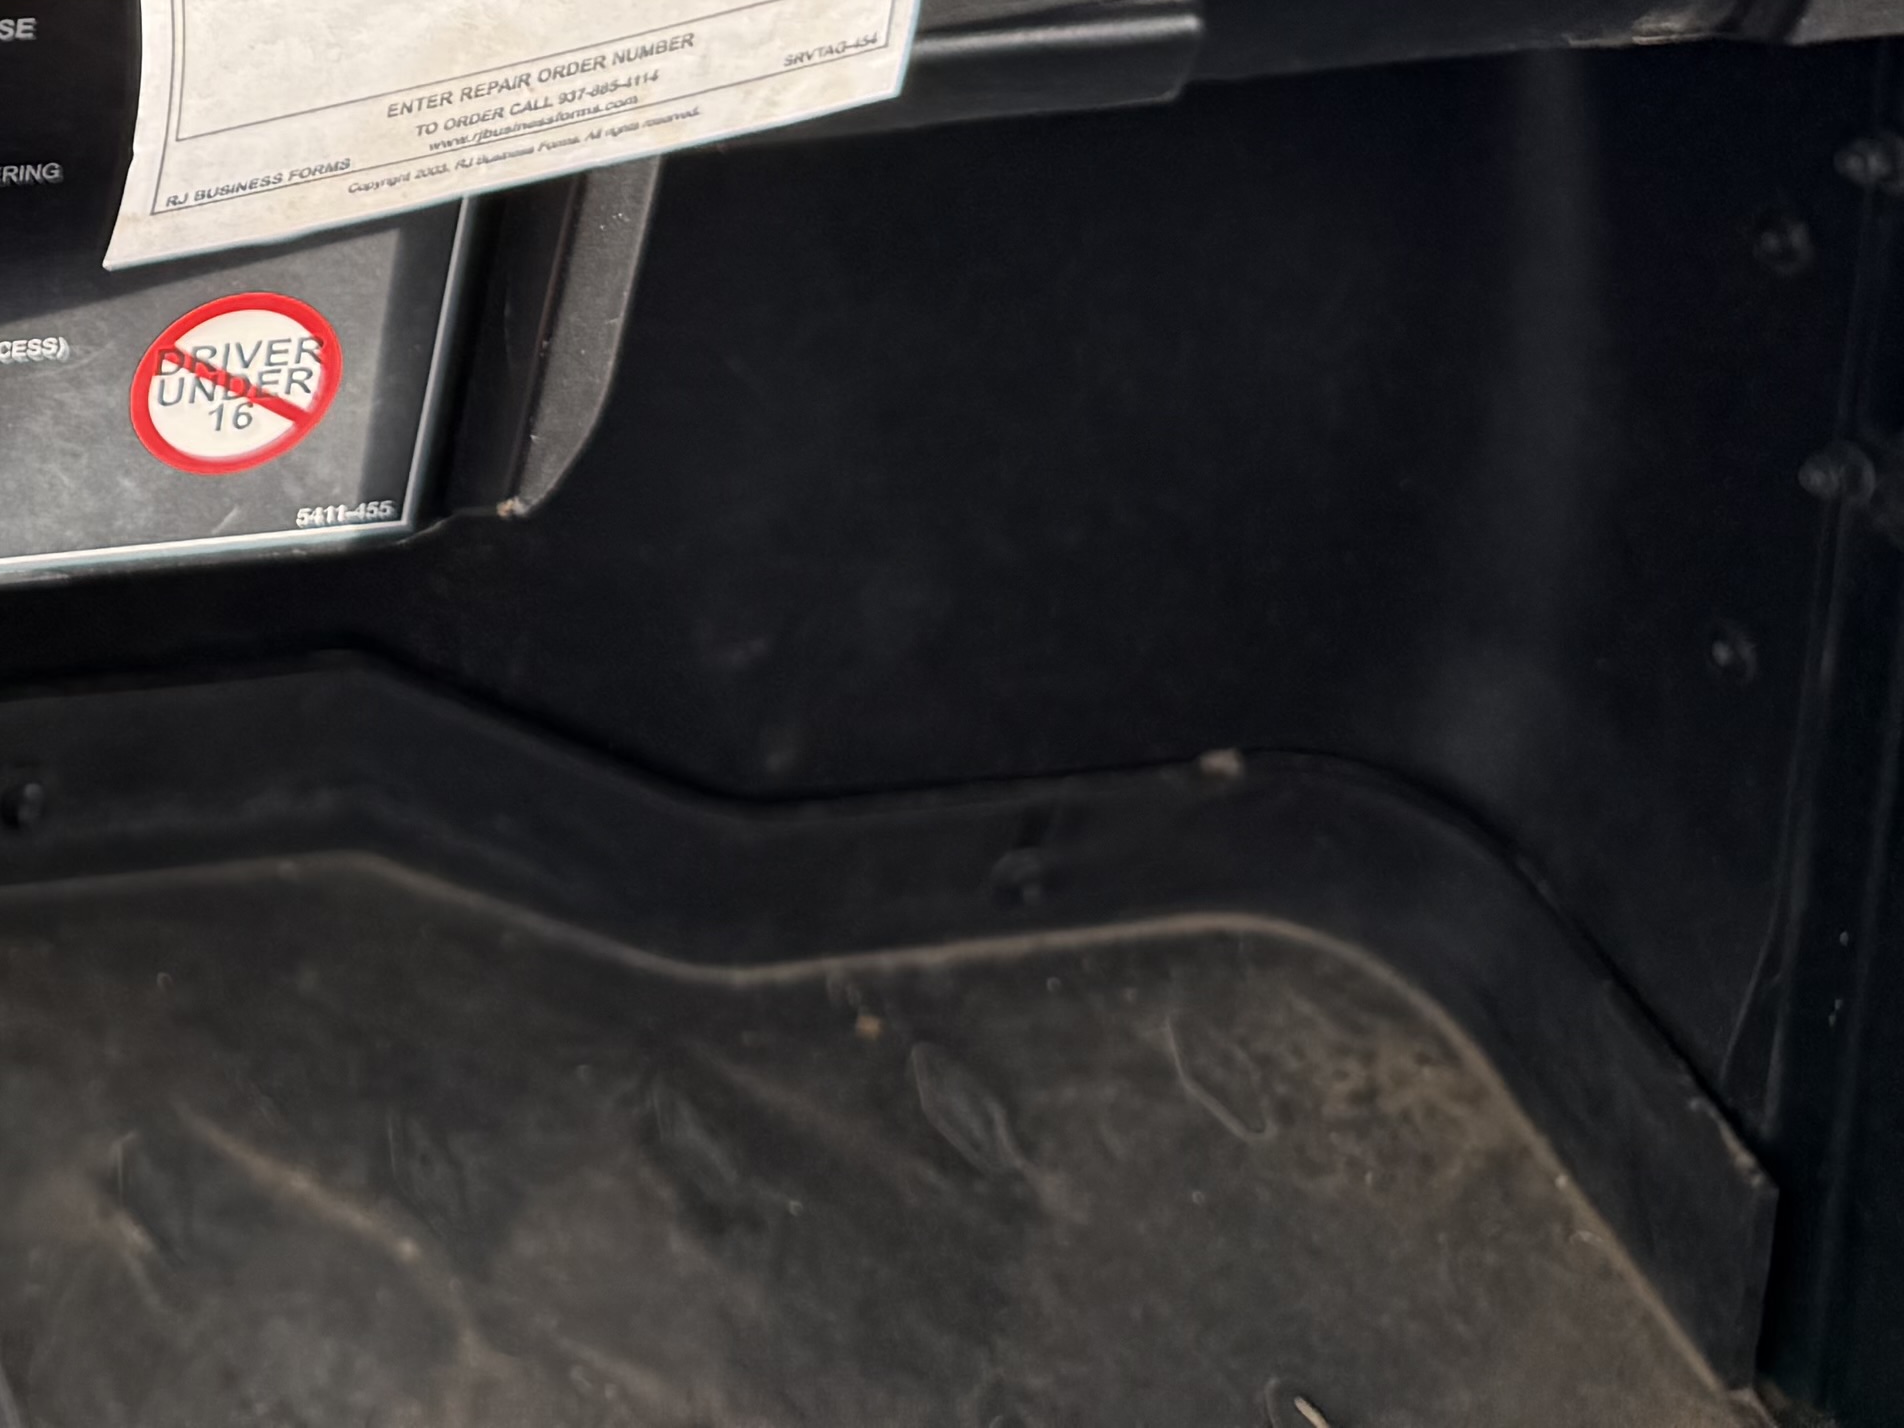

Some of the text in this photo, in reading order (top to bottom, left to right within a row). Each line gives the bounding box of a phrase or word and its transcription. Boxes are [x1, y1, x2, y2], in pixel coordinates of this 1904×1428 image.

[386, 32, 695, 119] ENTER REPAIR ORDER NUMBER
[415, 121, 439, 138] TO
[443, 106, 505, 131] ORDER
[509, 96, 554, 117] CALL
[166, 158, 351, 208] RJ BUSINESS FORMS
[156, 336, 325, 376] DRIVER
[157, 367, 313, 407] UNDER
[209, 402, 253, 432] 16
[296, 500, 395, 527] 5411-455
